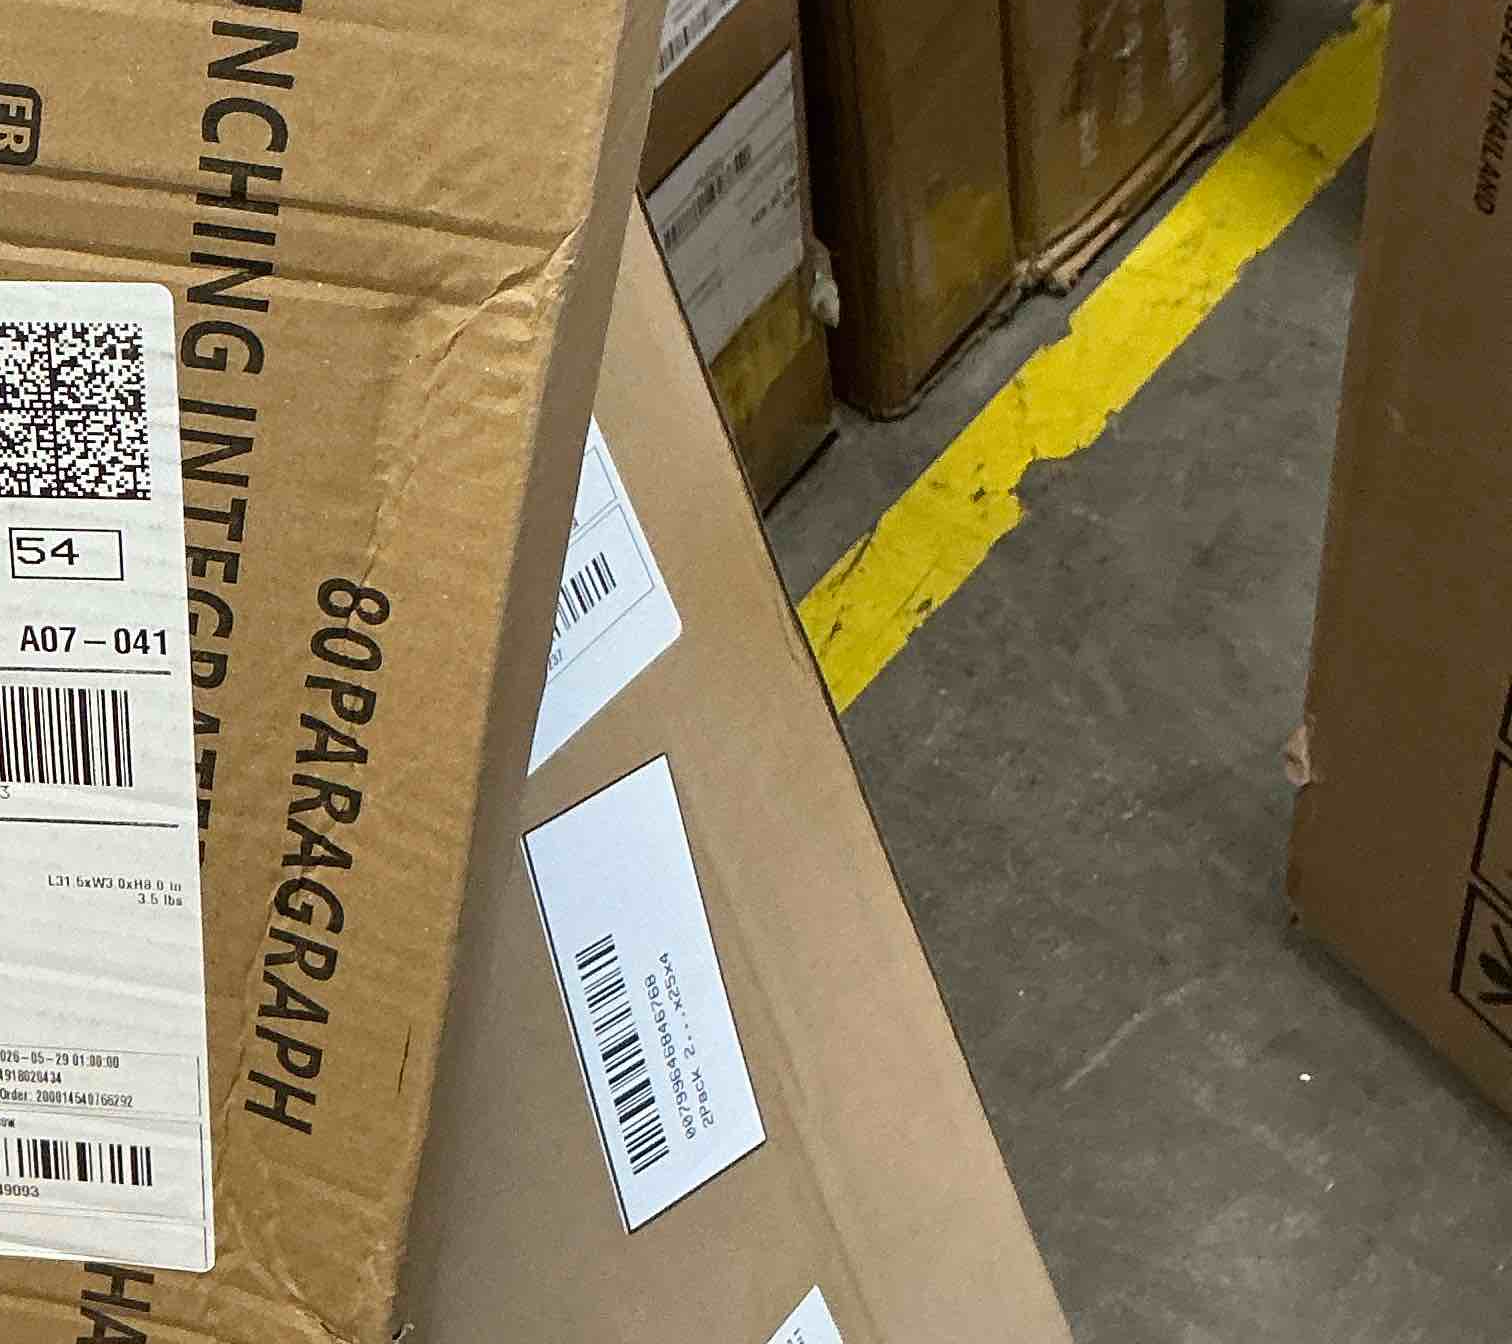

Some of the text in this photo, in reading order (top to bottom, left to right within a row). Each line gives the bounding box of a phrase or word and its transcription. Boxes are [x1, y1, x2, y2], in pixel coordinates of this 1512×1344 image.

[15, 536, 81, 567] 54
[243, 576, 391, 1136] 80PARAGRAPH
[0, 1087, 34, 1101] Order:
